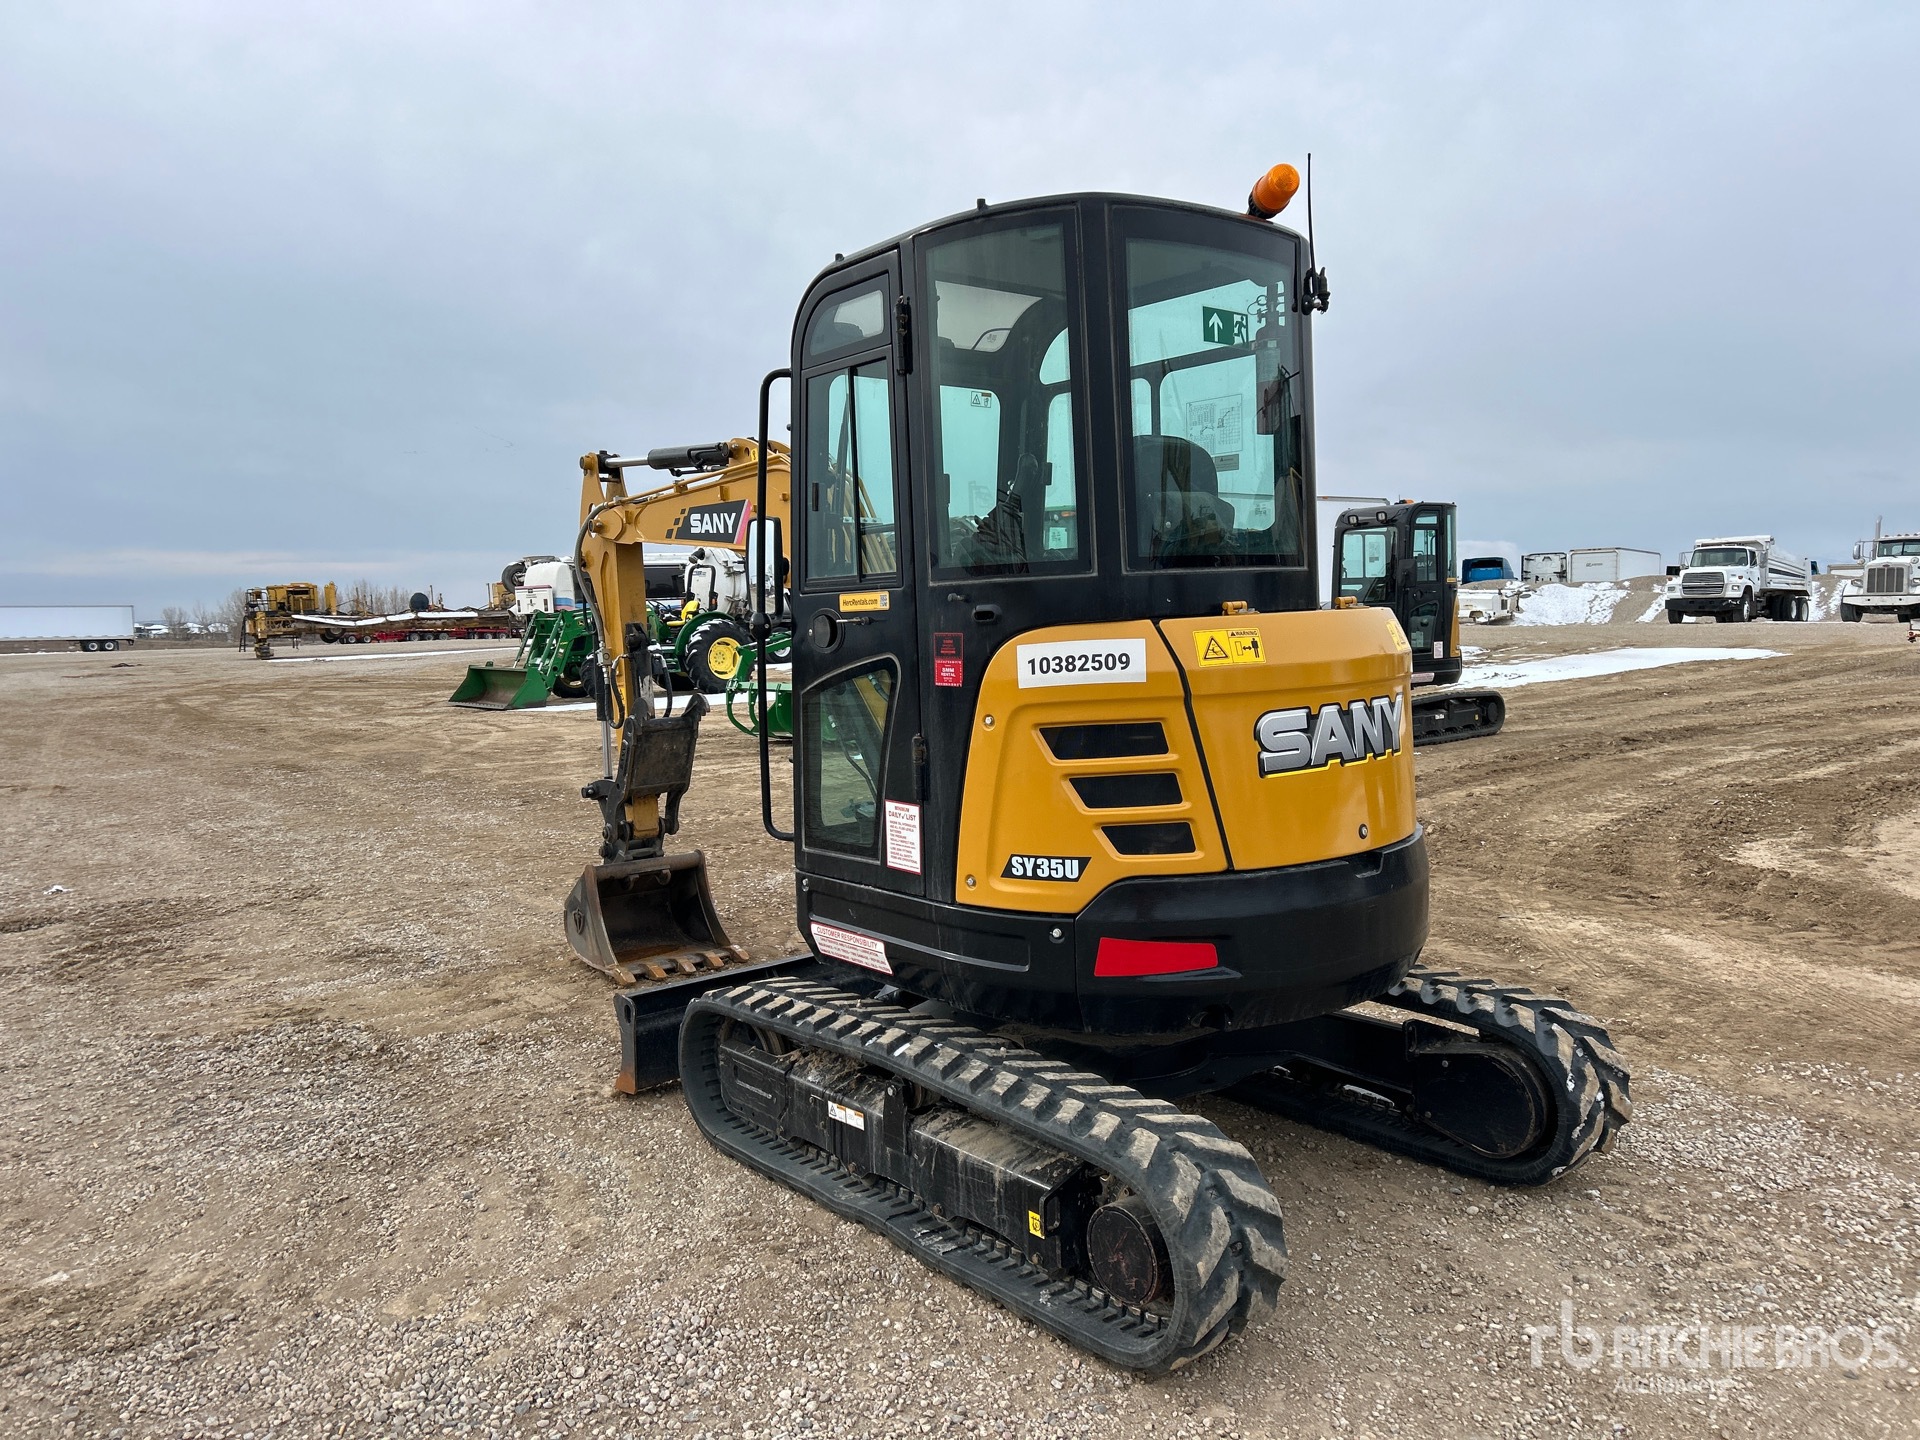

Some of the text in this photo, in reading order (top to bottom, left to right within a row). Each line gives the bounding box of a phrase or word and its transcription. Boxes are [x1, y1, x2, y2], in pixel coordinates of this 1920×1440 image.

[689, 512, 737, 534] SANY
[1027, 652, 1131, 676] 10382509
[1257, 692, 1404, 774] SANY
[888, 810, 916, 821] DAILY LIST
[1011, 856, 1079, 879] SY35U
[816, 926, 878, 949] CUSTOMER RESPONSIBILITY
